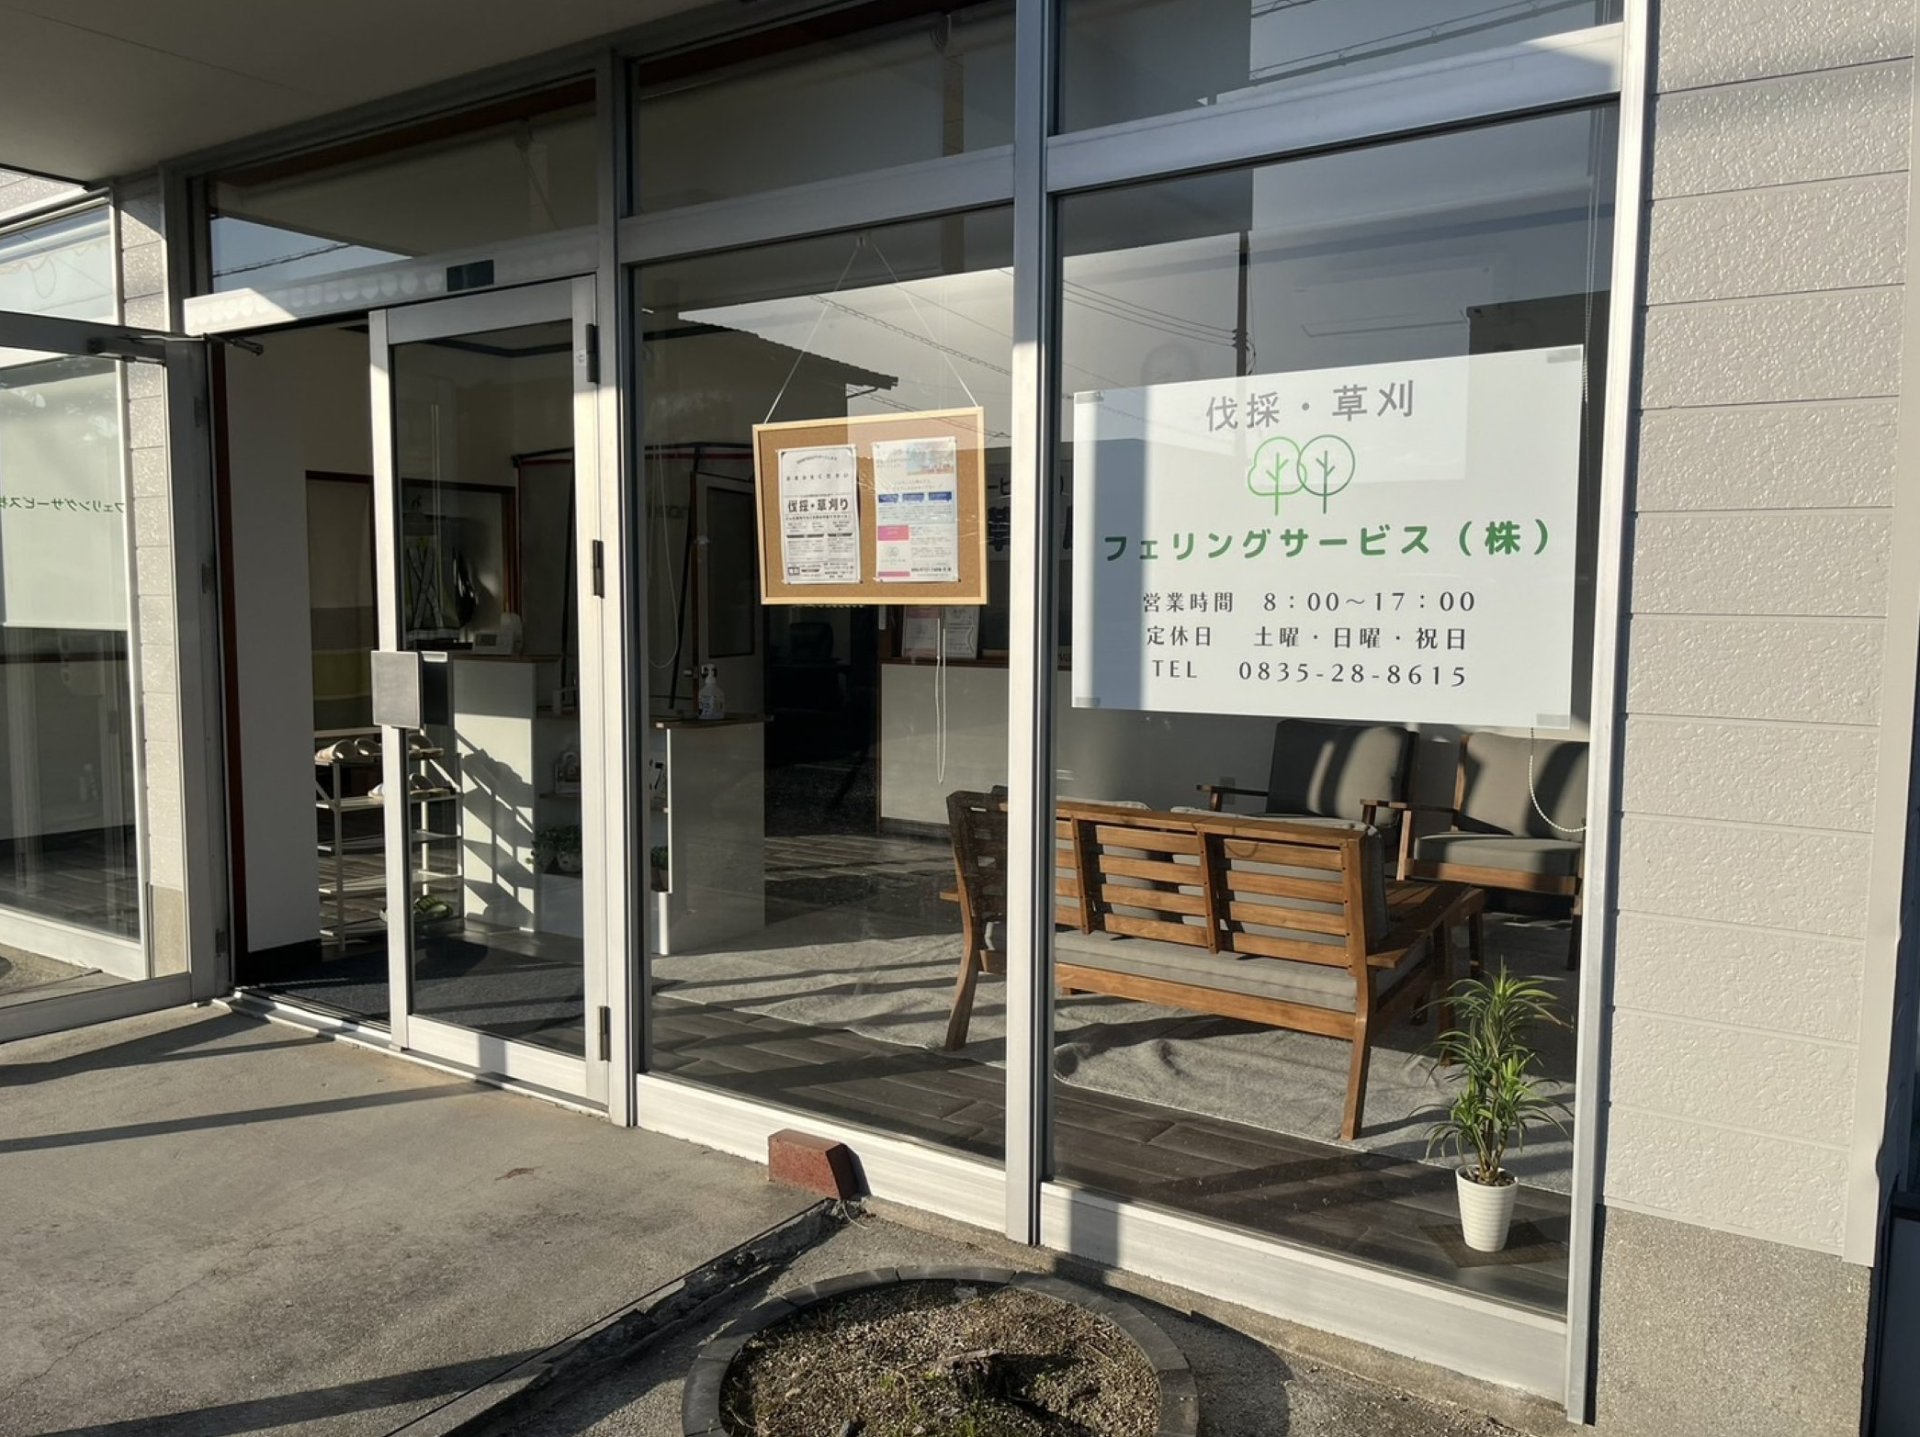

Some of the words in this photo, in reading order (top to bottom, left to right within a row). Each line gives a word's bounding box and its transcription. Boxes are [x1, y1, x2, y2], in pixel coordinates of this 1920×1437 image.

[1206, 380, 1414, 432] 伐採・草刈
[788, 498, 849, 513] 伐採・草刈り
[1104, 519, 1549, 561] フェリングサービス（株）
[1143, 592, 1233, 613] 営業時間
[1146, 626, 1212, 647] 定休日
[1253, 626, 1466, 650] 土曜・日曜・祝日
[1152, 660, 1198, 679] TEL
[1239, 661, 1466, 687] 0835-28-8615
